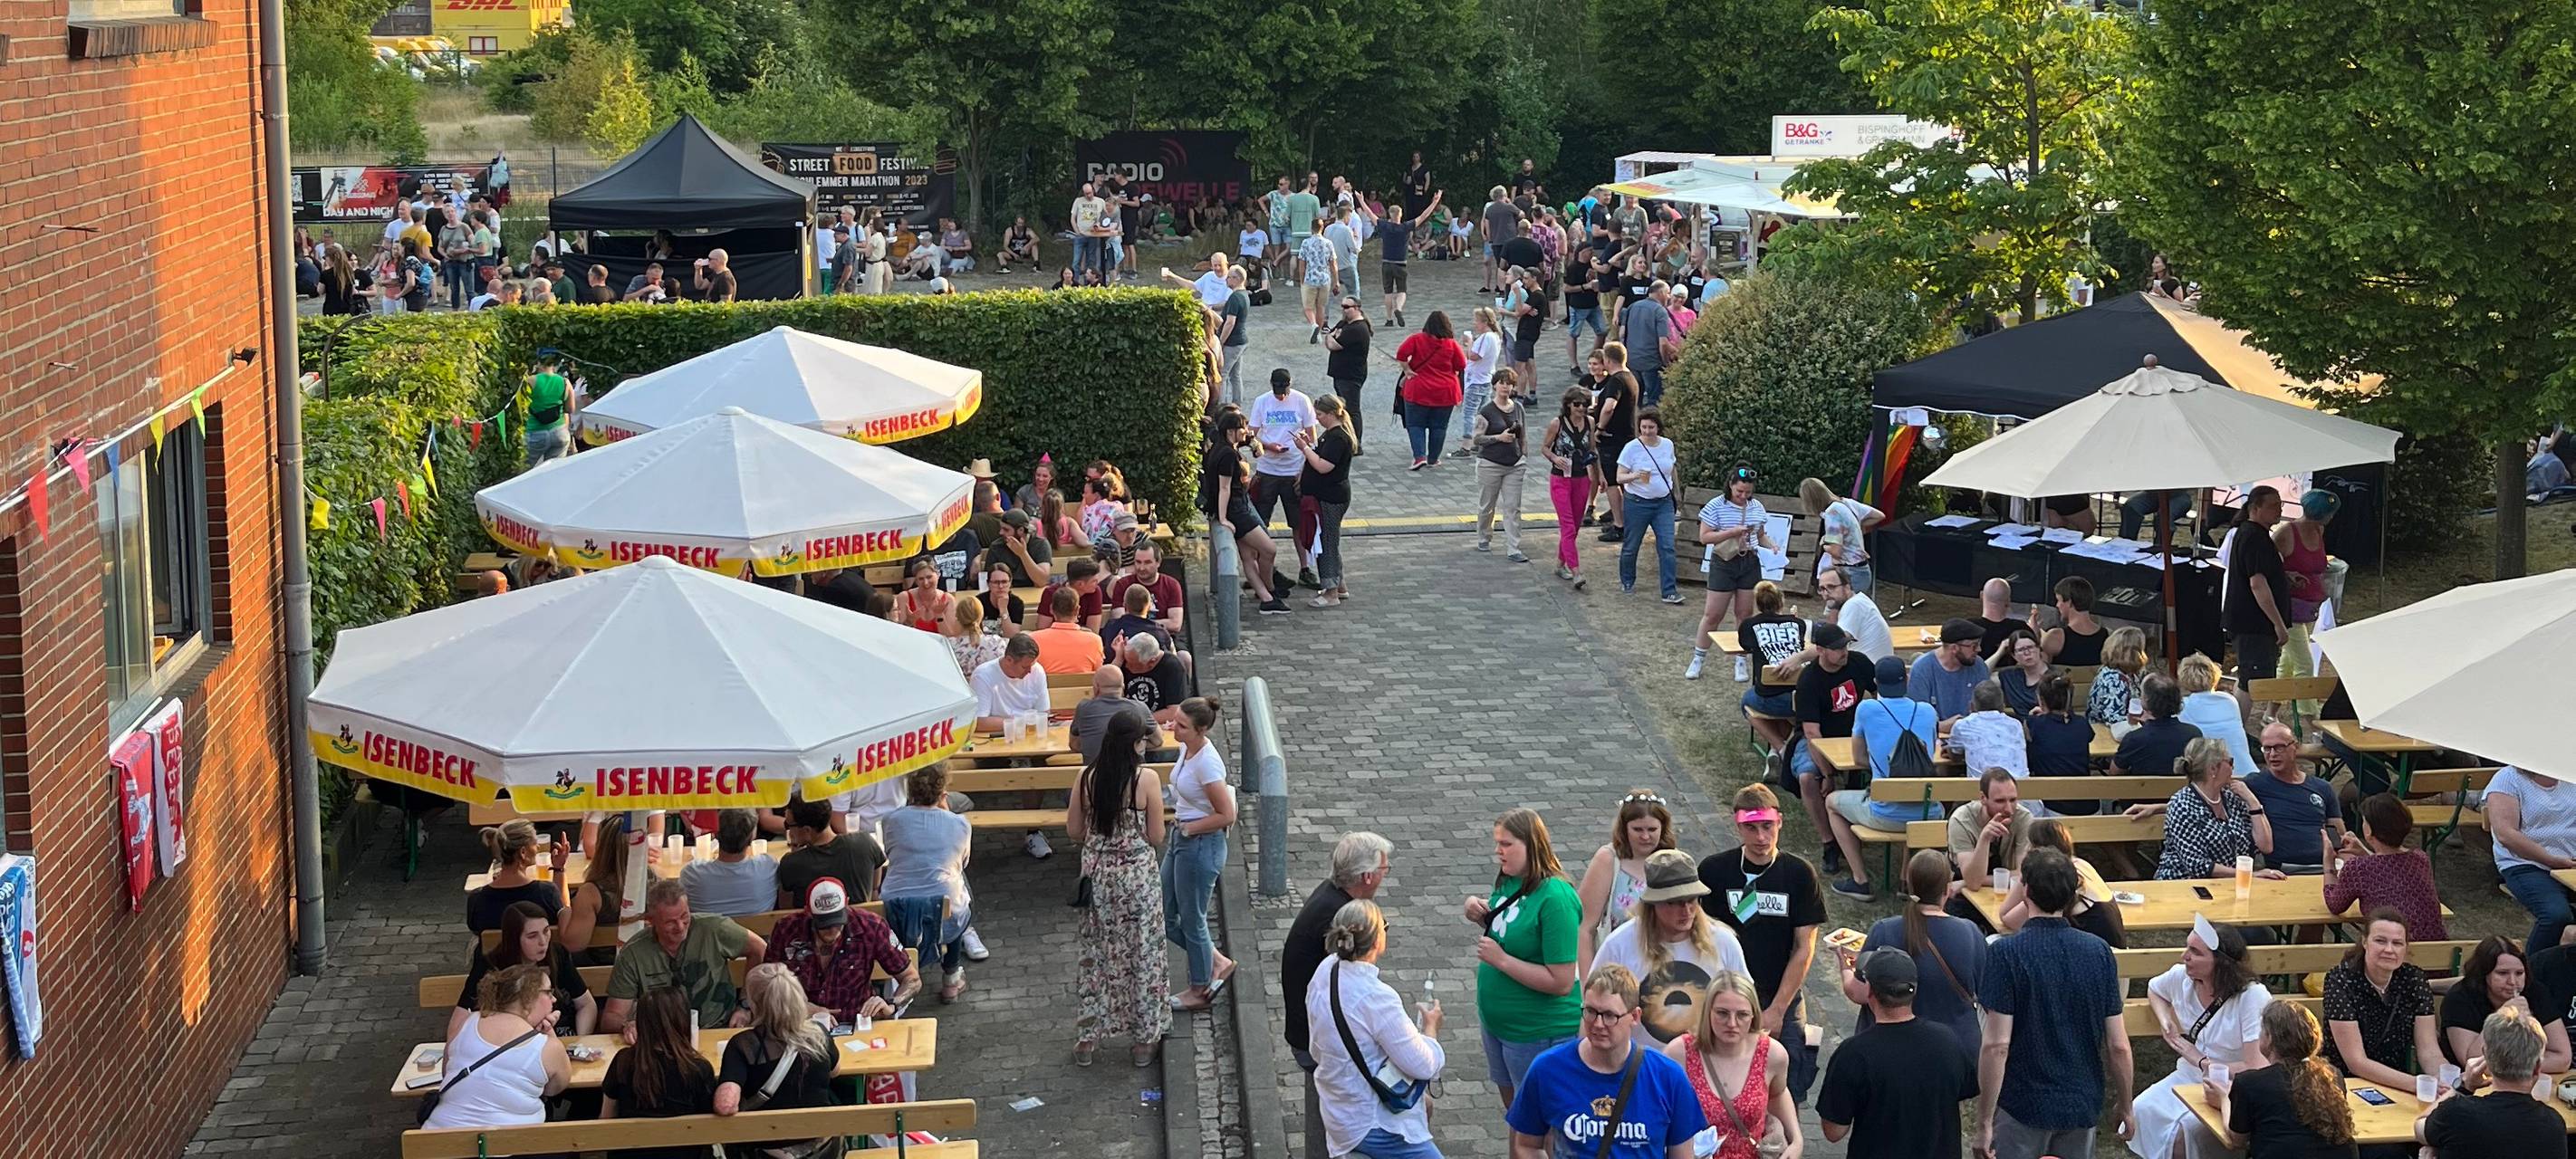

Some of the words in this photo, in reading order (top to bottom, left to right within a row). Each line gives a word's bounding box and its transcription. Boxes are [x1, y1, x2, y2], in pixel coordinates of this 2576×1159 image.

[1785, 123, 1818, 137] B&G
[1858, 125, 1925, 135] BISPINGHOFF
[790, 158, 830, 172] STREET
[839, 157, 873, 171] FOOD
[880, 158, 929, 170] FESTIV
[795, 177, 849, 187] HLEMMER
[851, 175, 900, 187] MARATHON
[905, 175, 928, 186] 2023
[322, 207, 343, 217] DAY
[346, 206, 369, 217] AND
[370, 206, 394, 216] NIGH
[865, 408, 939, 437] ISENBECK
[495, 513, 541, 551] ISENBECK
[805, 528, 904, 561] ISENBECK
[610, 541, 721, 569] ISENBECK
[1757, 627, 1800, 644] BIER
[362, 730, 476, 790] ISENBECK
[856, 716, 956, 776] ISENBECK
[596, 765, 758, 798] ISENBECK
[1563, 1113, 1648, 1145] Corna
